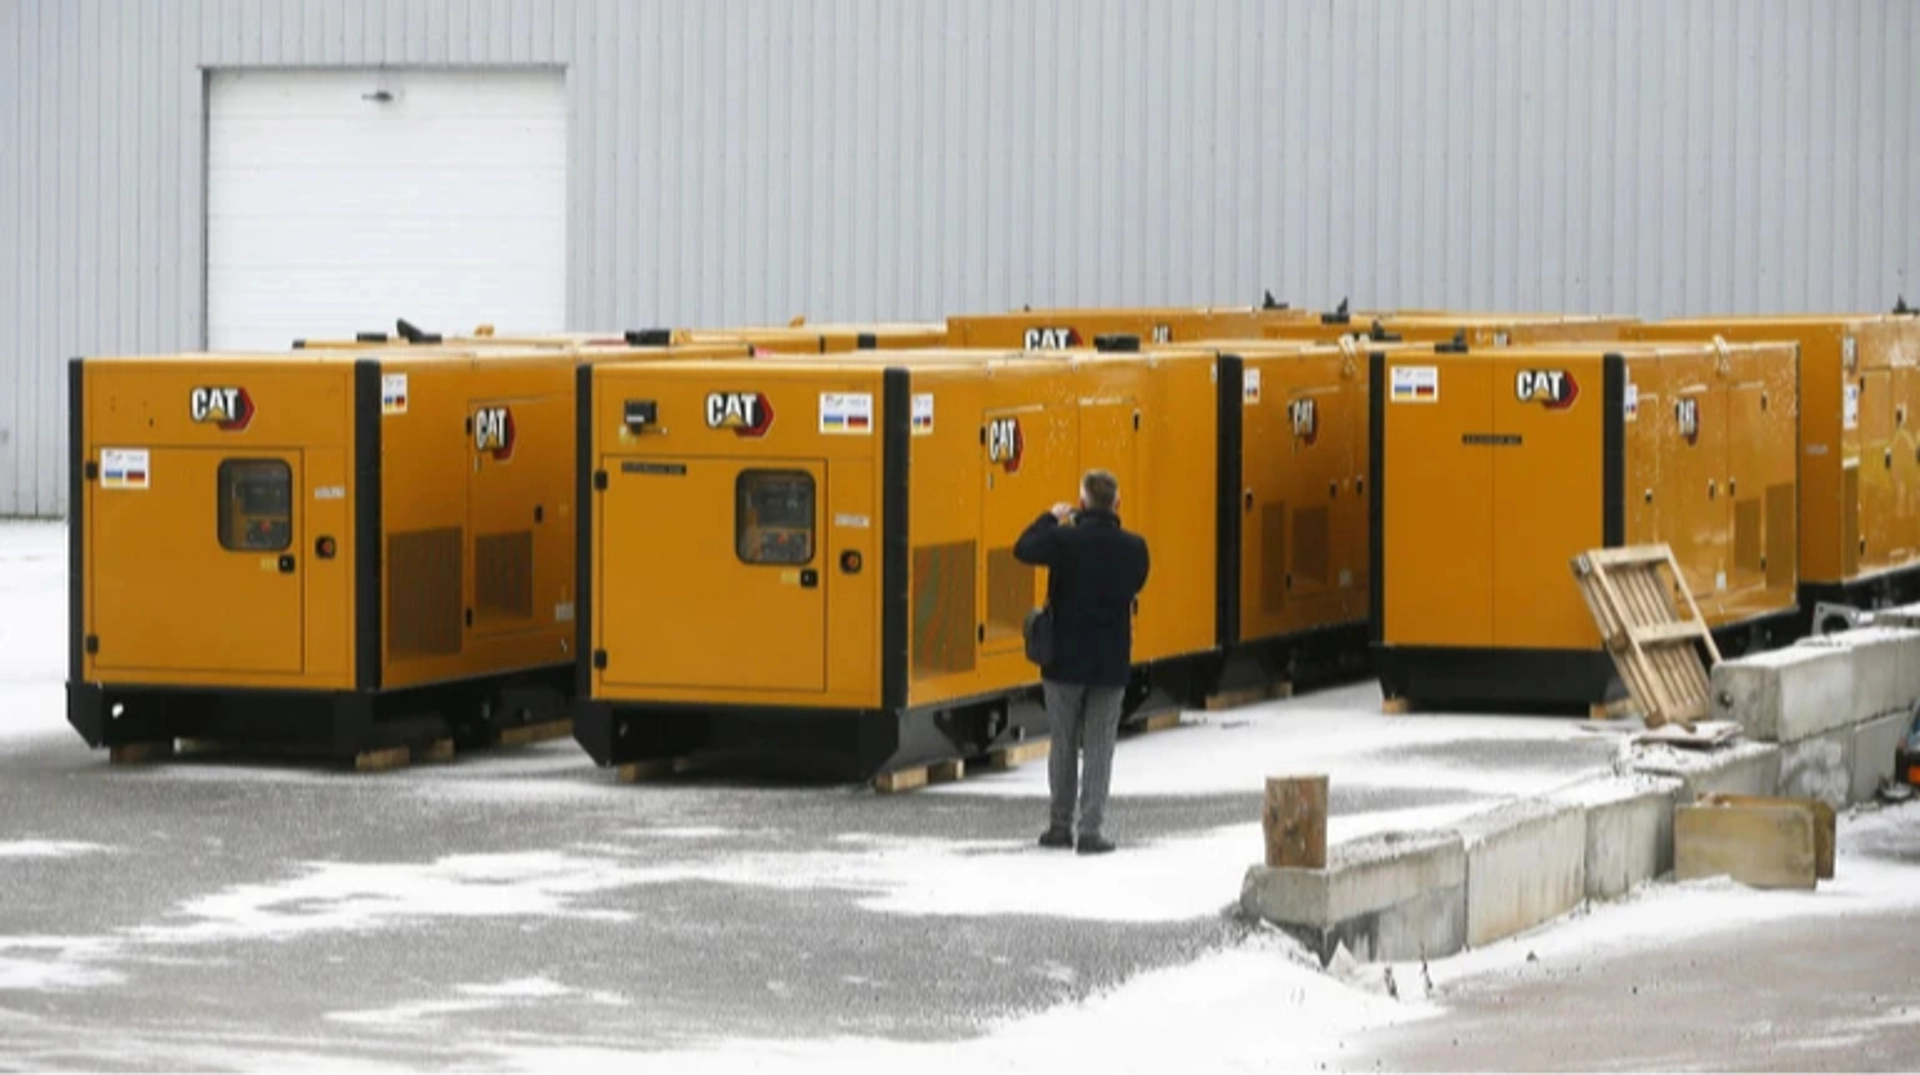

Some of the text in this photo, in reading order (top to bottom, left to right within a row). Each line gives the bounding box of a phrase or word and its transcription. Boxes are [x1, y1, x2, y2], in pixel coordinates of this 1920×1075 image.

[1517, 370, 1564, 402] CAT
[192, 388, 239, 422] CAT
[707, 393, 758, 428] CAT
[476, 409, 507, 450] CAT
[990, 419, 1016, 461] CAT
